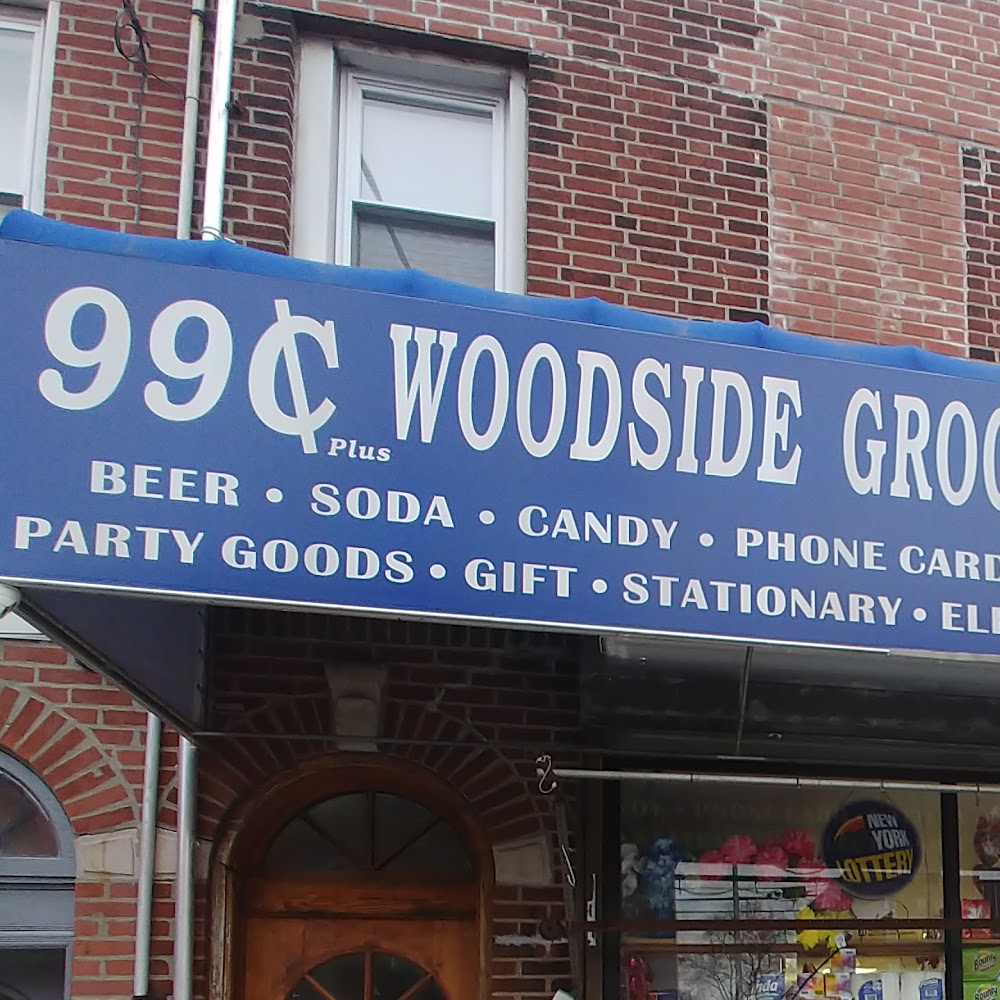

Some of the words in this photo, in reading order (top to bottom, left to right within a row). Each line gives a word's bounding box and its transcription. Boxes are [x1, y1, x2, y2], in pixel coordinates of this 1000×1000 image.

[39, 285, 339, 454] 99¢
[390, 322, 803, 486] WOODSIDE
[327, 437, 391, 462] Plus
[90, 460, 239, 506] BEER
[310, 483, 455, 528] SODA
[516, 505, 679, 549] CANDY
[736, 527, 886, 571] PHONE
[14, 515, 204, 564] PARTY
[221, 535, 414, 583] GOODS
[464, 558, 578, 598] GIFT
[622, 572, 902, 626] STATIONARY
[866, 813, 899, 829] NEW
[871, 828, 910, 851] YORK
[836, 848, 914, 884] LOTTERY
